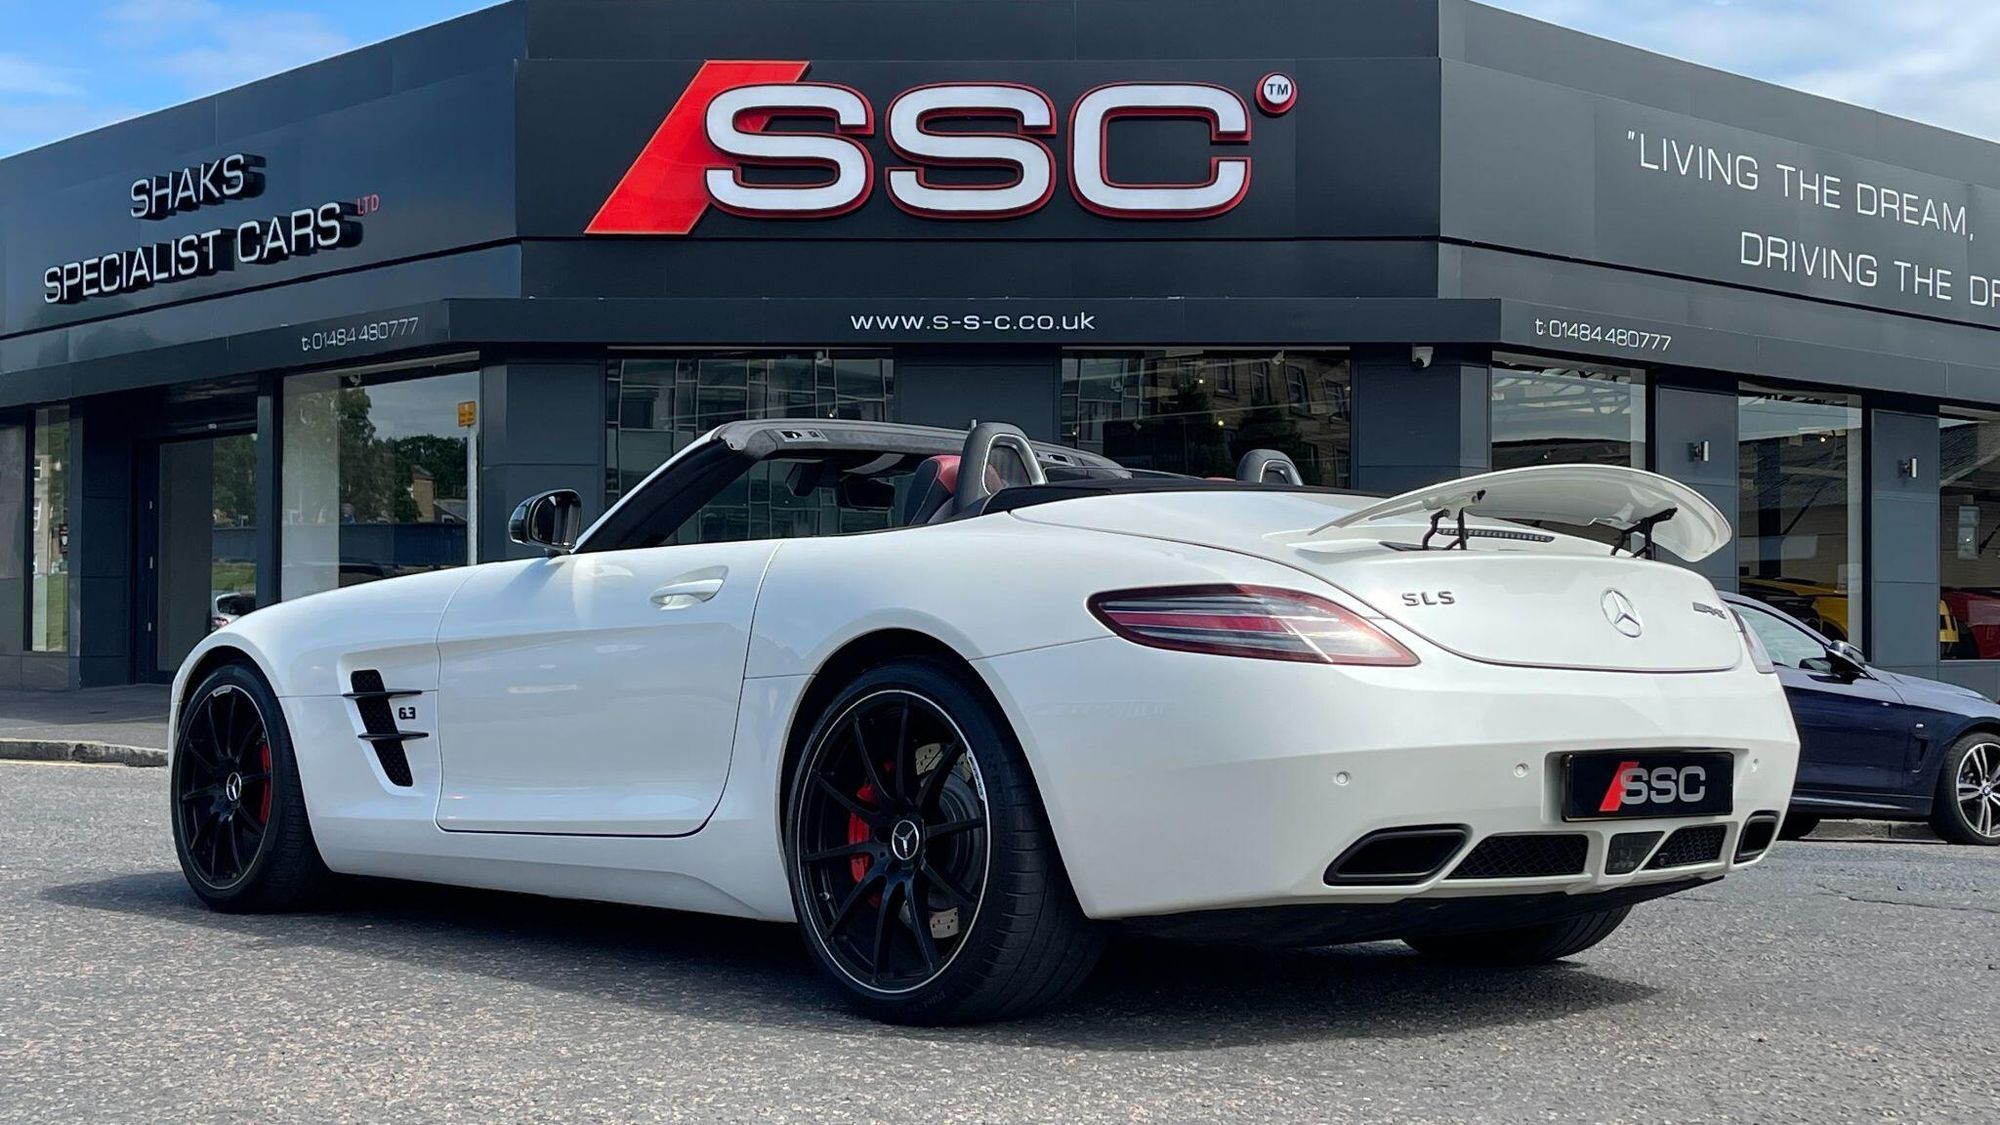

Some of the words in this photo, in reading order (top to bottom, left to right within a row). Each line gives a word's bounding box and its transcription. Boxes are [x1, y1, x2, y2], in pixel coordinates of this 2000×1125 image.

[704, 82, 1253, 221] SSC
[1267, 83, 1289, 96] TM
[130, 153, 246, 219] SHAKS
[1776, 163, 1842, 210] THE
[1856, 182, 1975, 242] DREAM,
[43, 229, 222, 304] SPECIALIST
[237, 202, 342, 264] CARS
[357, 194, 380, 215] LTD
[1740, 231, 1878, 287] DRIVING
[1893, 260, 1952, 301] THE
[850, 311, 1097, 331] www.s-s-c.co.uk
[1401, 590, 1456, 607] SLS
[1620, 765, 1706, 805] SSC
